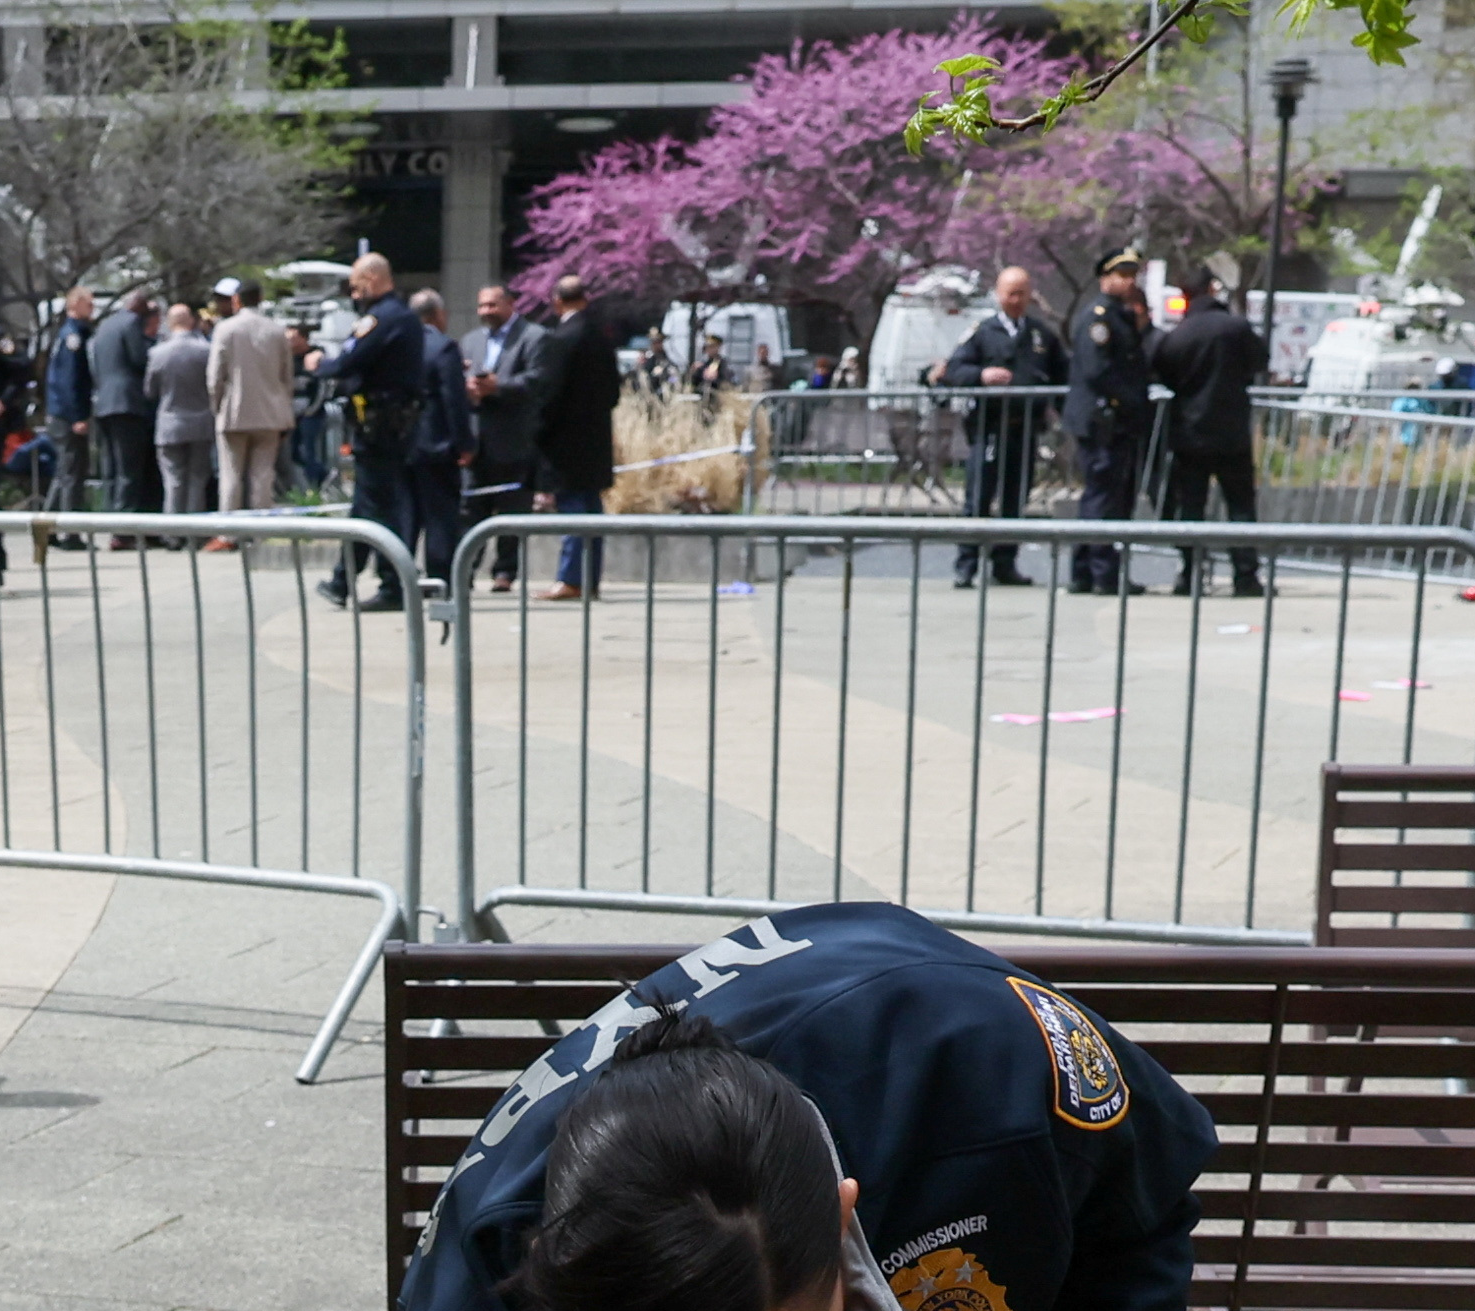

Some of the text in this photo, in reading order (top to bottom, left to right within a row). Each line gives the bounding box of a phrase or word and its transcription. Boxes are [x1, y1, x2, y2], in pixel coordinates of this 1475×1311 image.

[1089, 1091, 1123, 1121] CITY OF
[880, 1214, 989, 1275] COMMISSIONER
